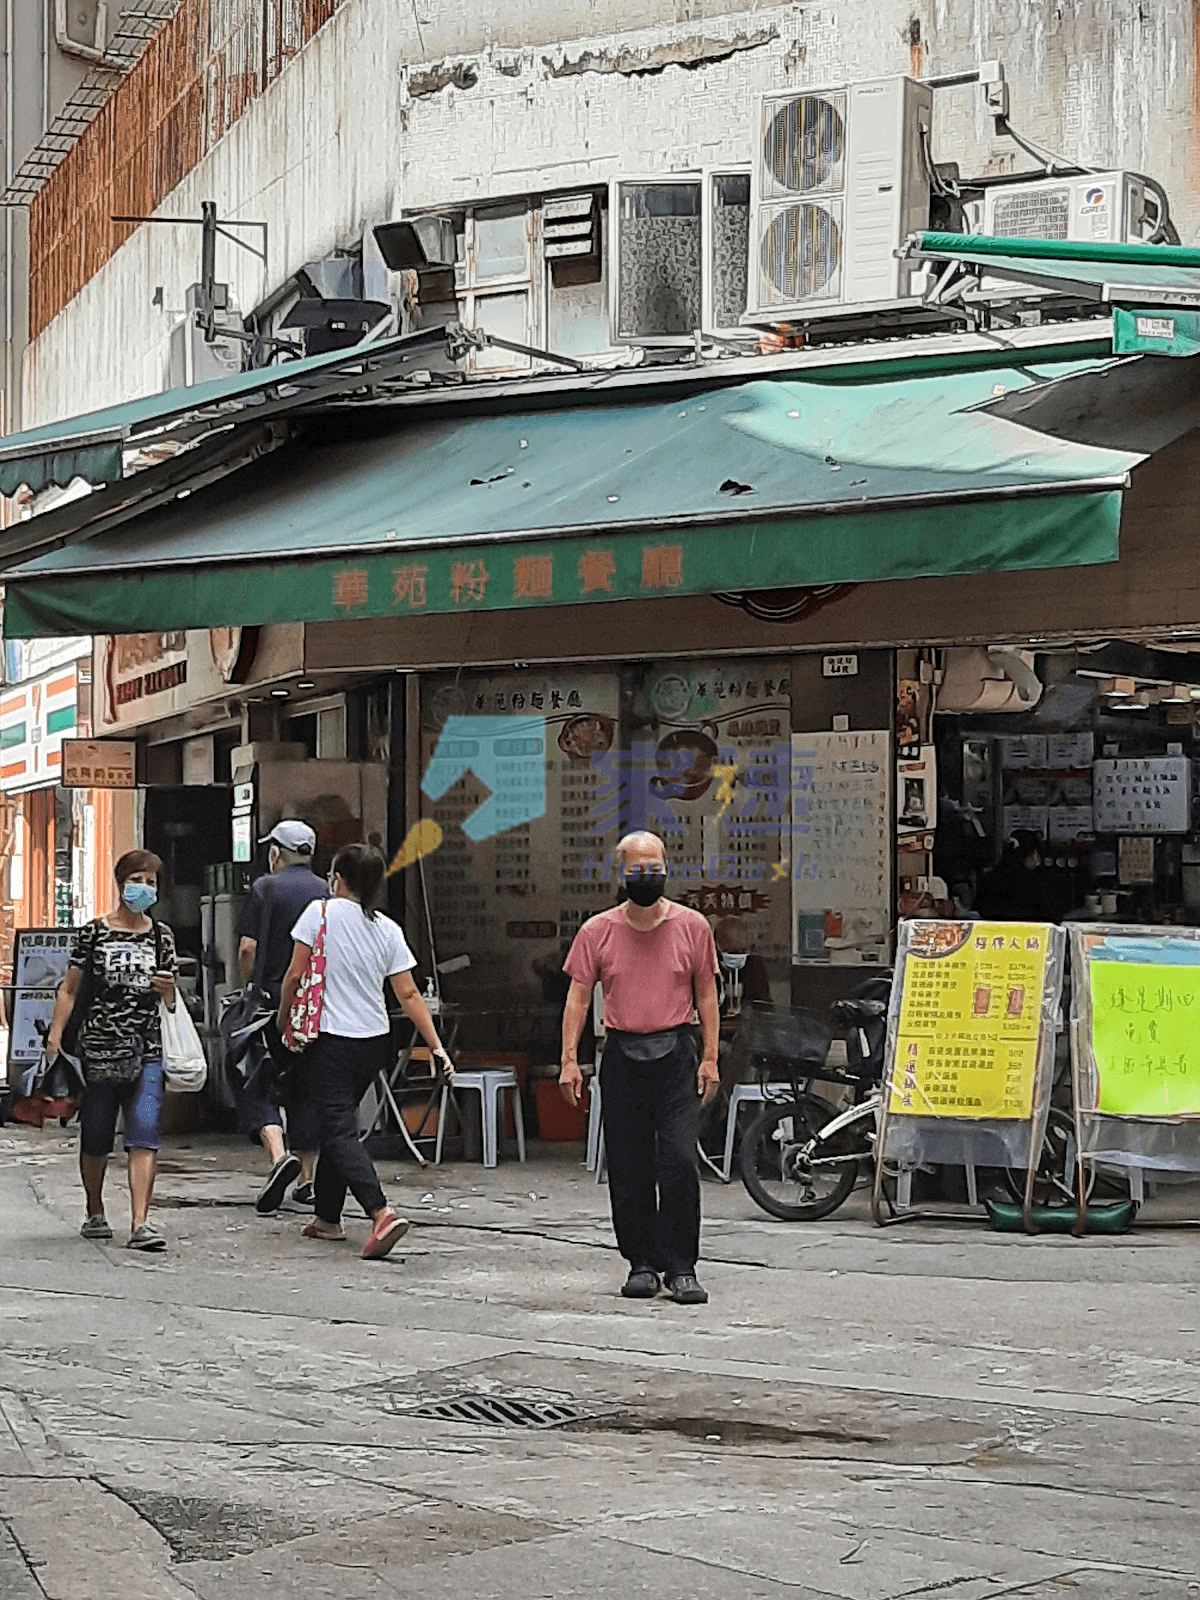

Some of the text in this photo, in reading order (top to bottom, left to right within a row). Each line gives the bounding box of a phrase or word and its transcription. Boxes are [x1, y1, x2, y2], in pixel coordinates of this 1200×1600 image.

[333, 544, 684, 614] 華苑粉麵餐廳
